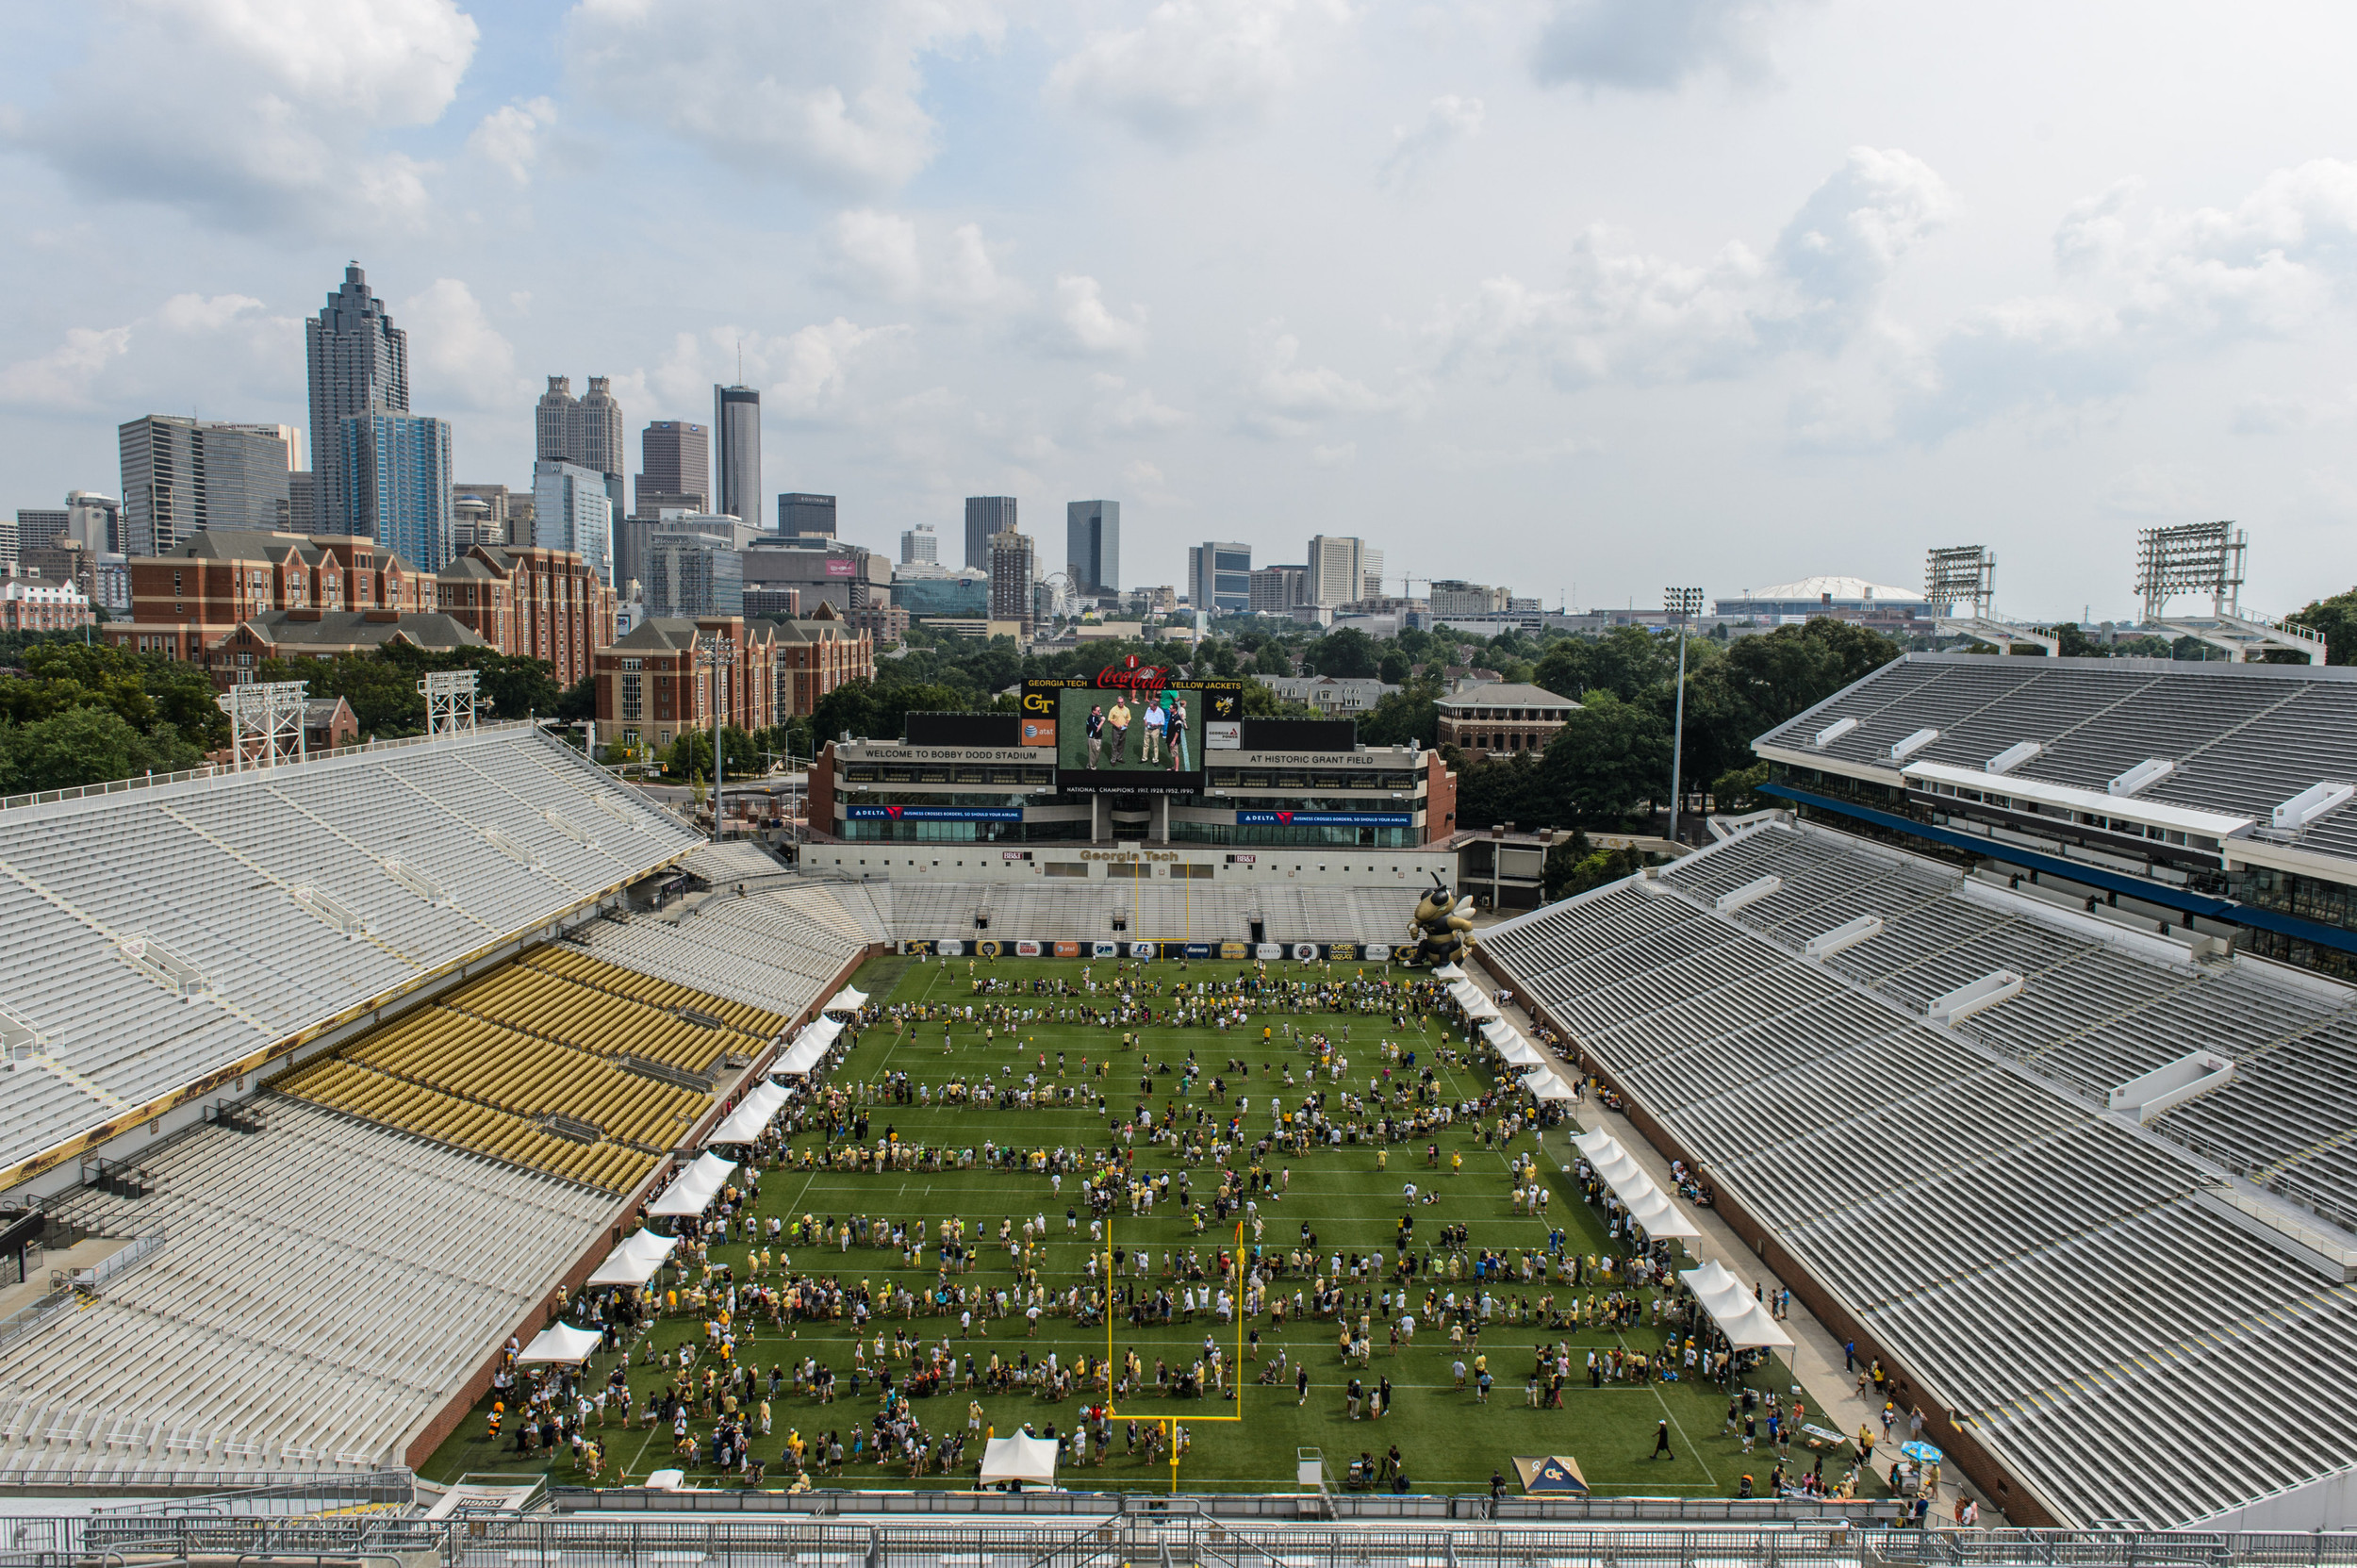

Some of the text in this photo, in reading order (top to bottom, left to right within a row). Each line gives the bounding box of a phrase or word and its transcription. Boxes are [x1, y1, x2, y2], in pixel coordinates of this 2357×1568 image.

[551, 465, 561, 473] W
[1097, 665, 1169, 689] Coca-Cola
[1029, 679, 1064, 687] GEORGIA
[1205, 682, 1242, 690] JACKETS
[1023, 694, 1054, 714] GT
[865, 750, 913, 758] WELCOME
[931, 751, 963, 759] BOBBY
[995, 751, 1037, 760] STADIUM
[1265, 755, 1310, 764] HISTORIC
[1346, 756, 1374, 765] FIELD
[1080, 850, 1178, 863] Georgia Tech
[1544, 1468, 1563, 1480] GT
[459, 1498, 503, 1507] TOUGH
